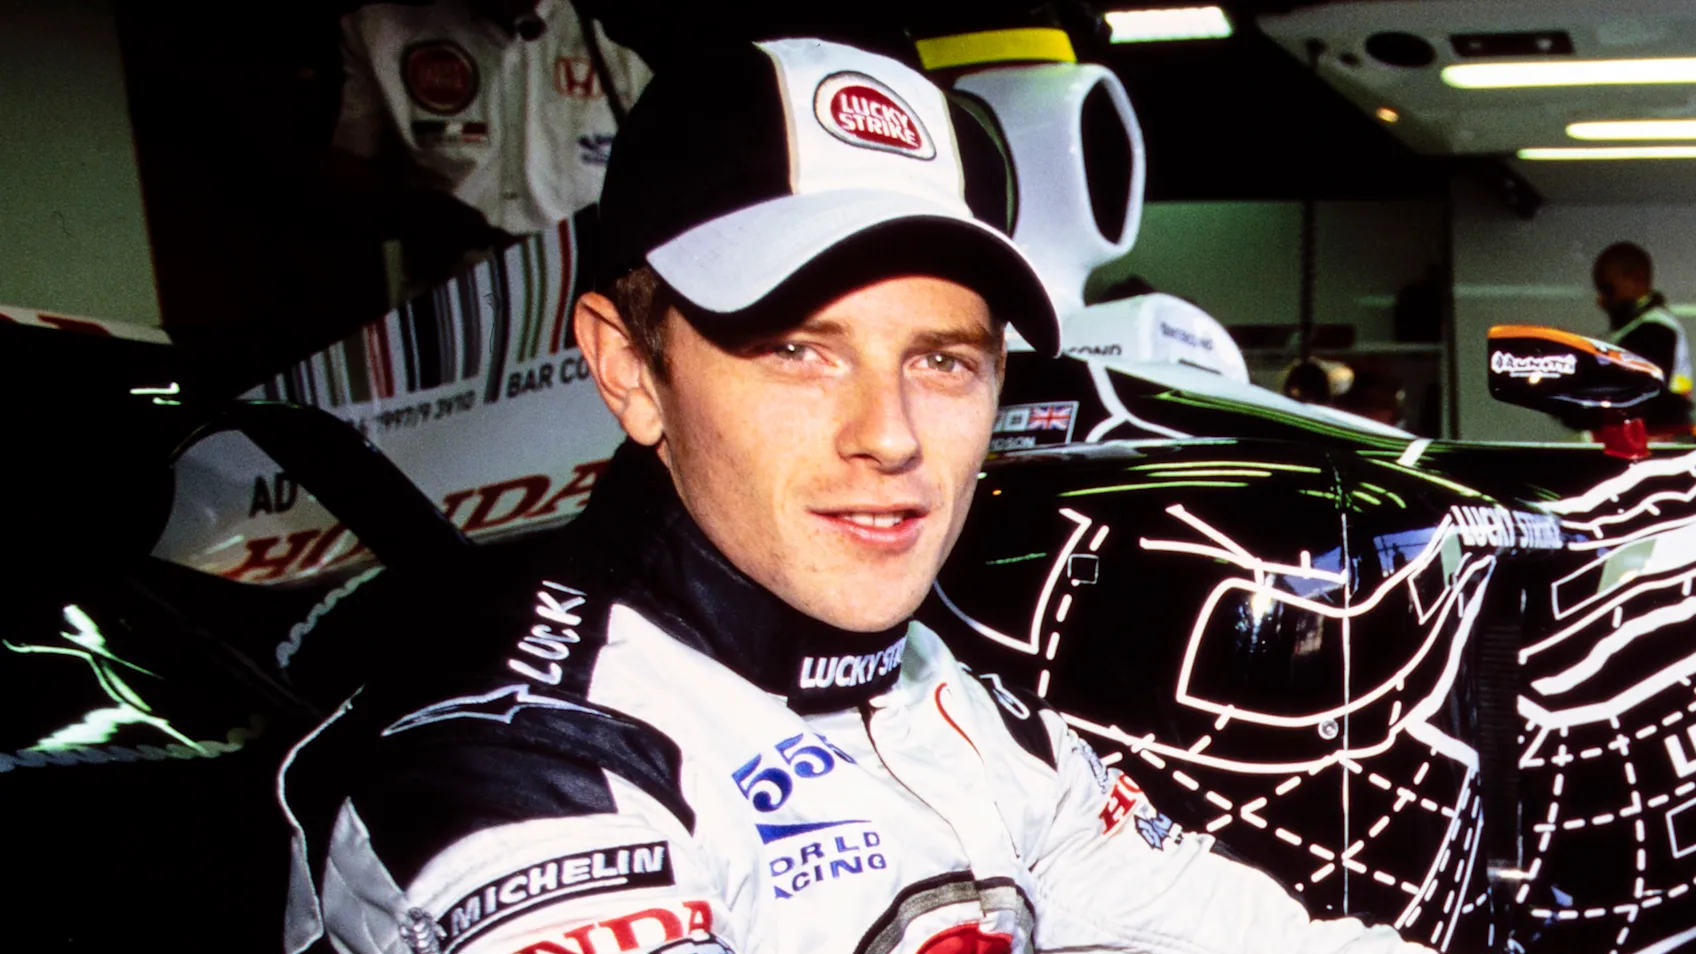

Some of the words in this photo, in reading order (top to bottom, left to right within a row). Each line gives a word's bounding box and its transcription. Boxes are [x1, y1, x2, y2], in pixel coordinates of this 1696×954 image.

[838, 112, 919, 148] STRIKE
[840, 93, 909, 130] LUCKY
[506, 363, 554, 399] BAR
[799, 651, 884, 689] LUCKY
[451, 845, 665, 937] MICHELIN
